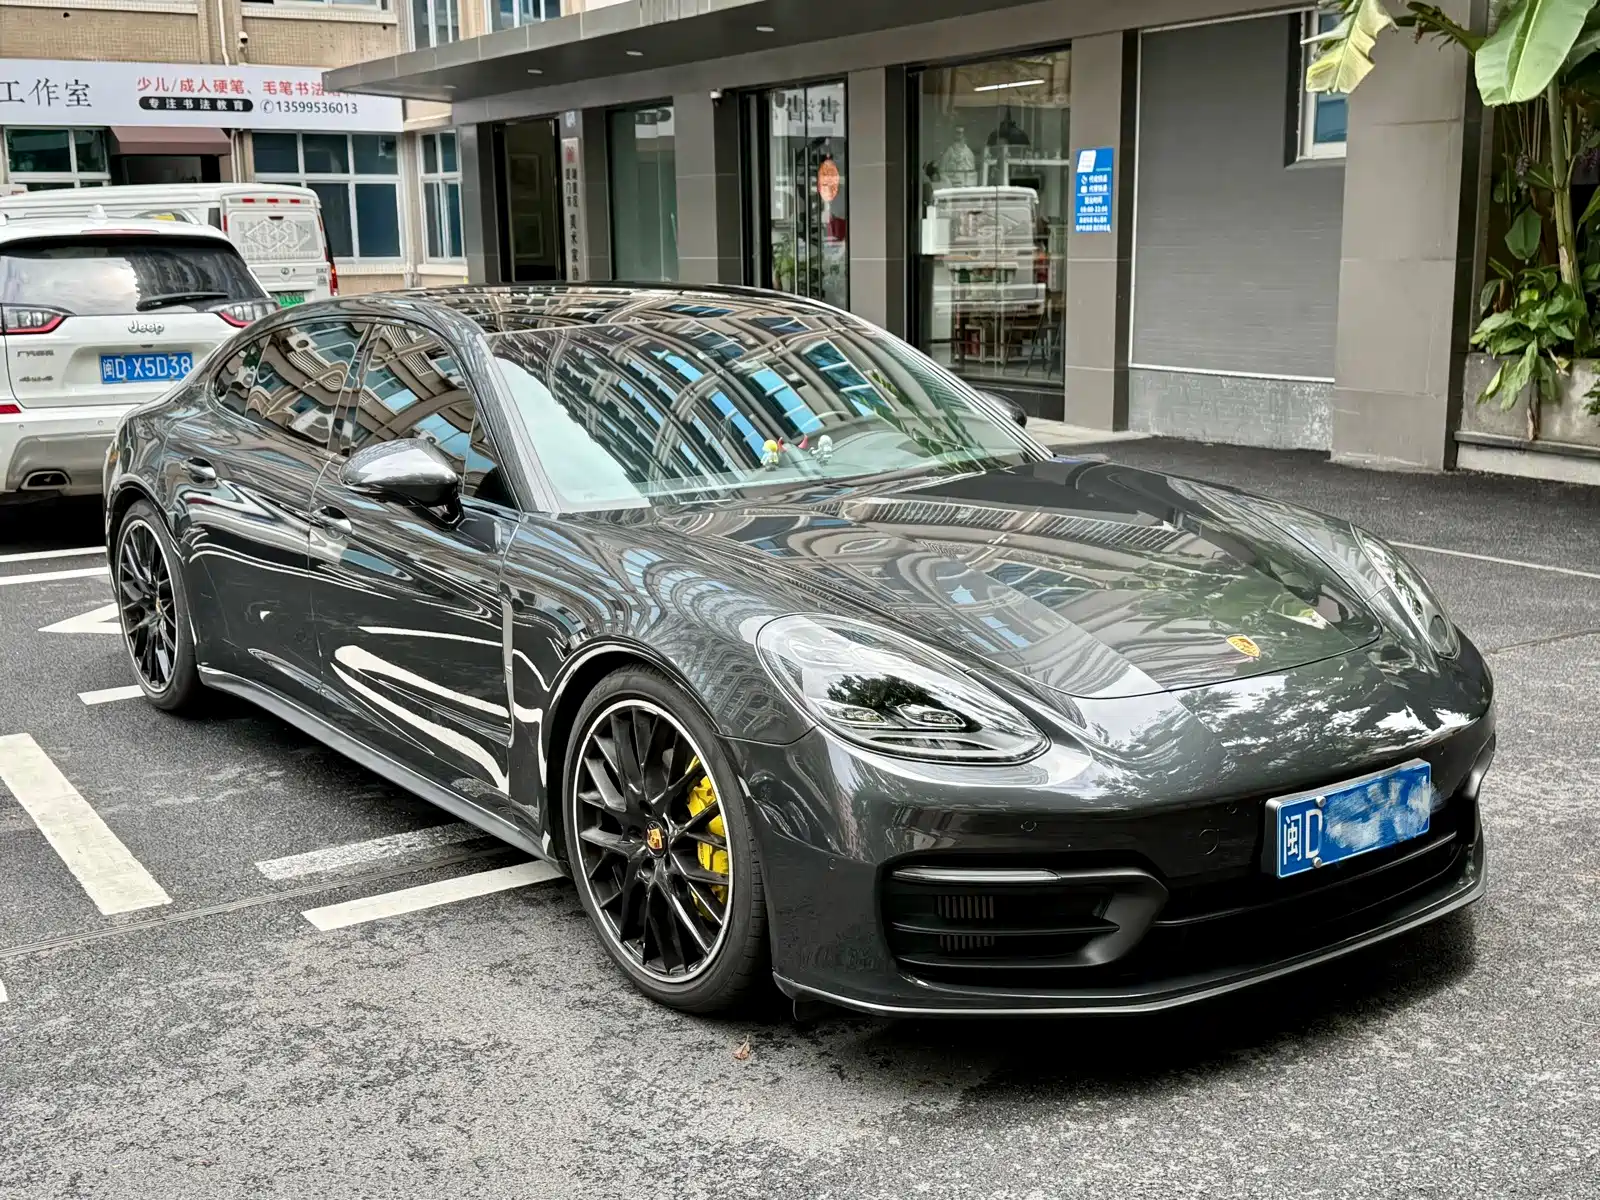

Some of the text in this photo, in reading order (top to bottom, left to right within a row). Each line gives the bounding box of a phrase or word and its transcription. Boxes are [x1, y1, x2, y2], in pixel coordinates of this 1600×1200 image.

[0, 77, 92, 107] 工作室
[137, 76, 357, 97] 少儿/成人硬笔、毛笔书法
[148, 98, 244, 111] 专注书法教育
[276, 101, 358, 114] 13599536013
[128, 320, 165, 335] Jeep
